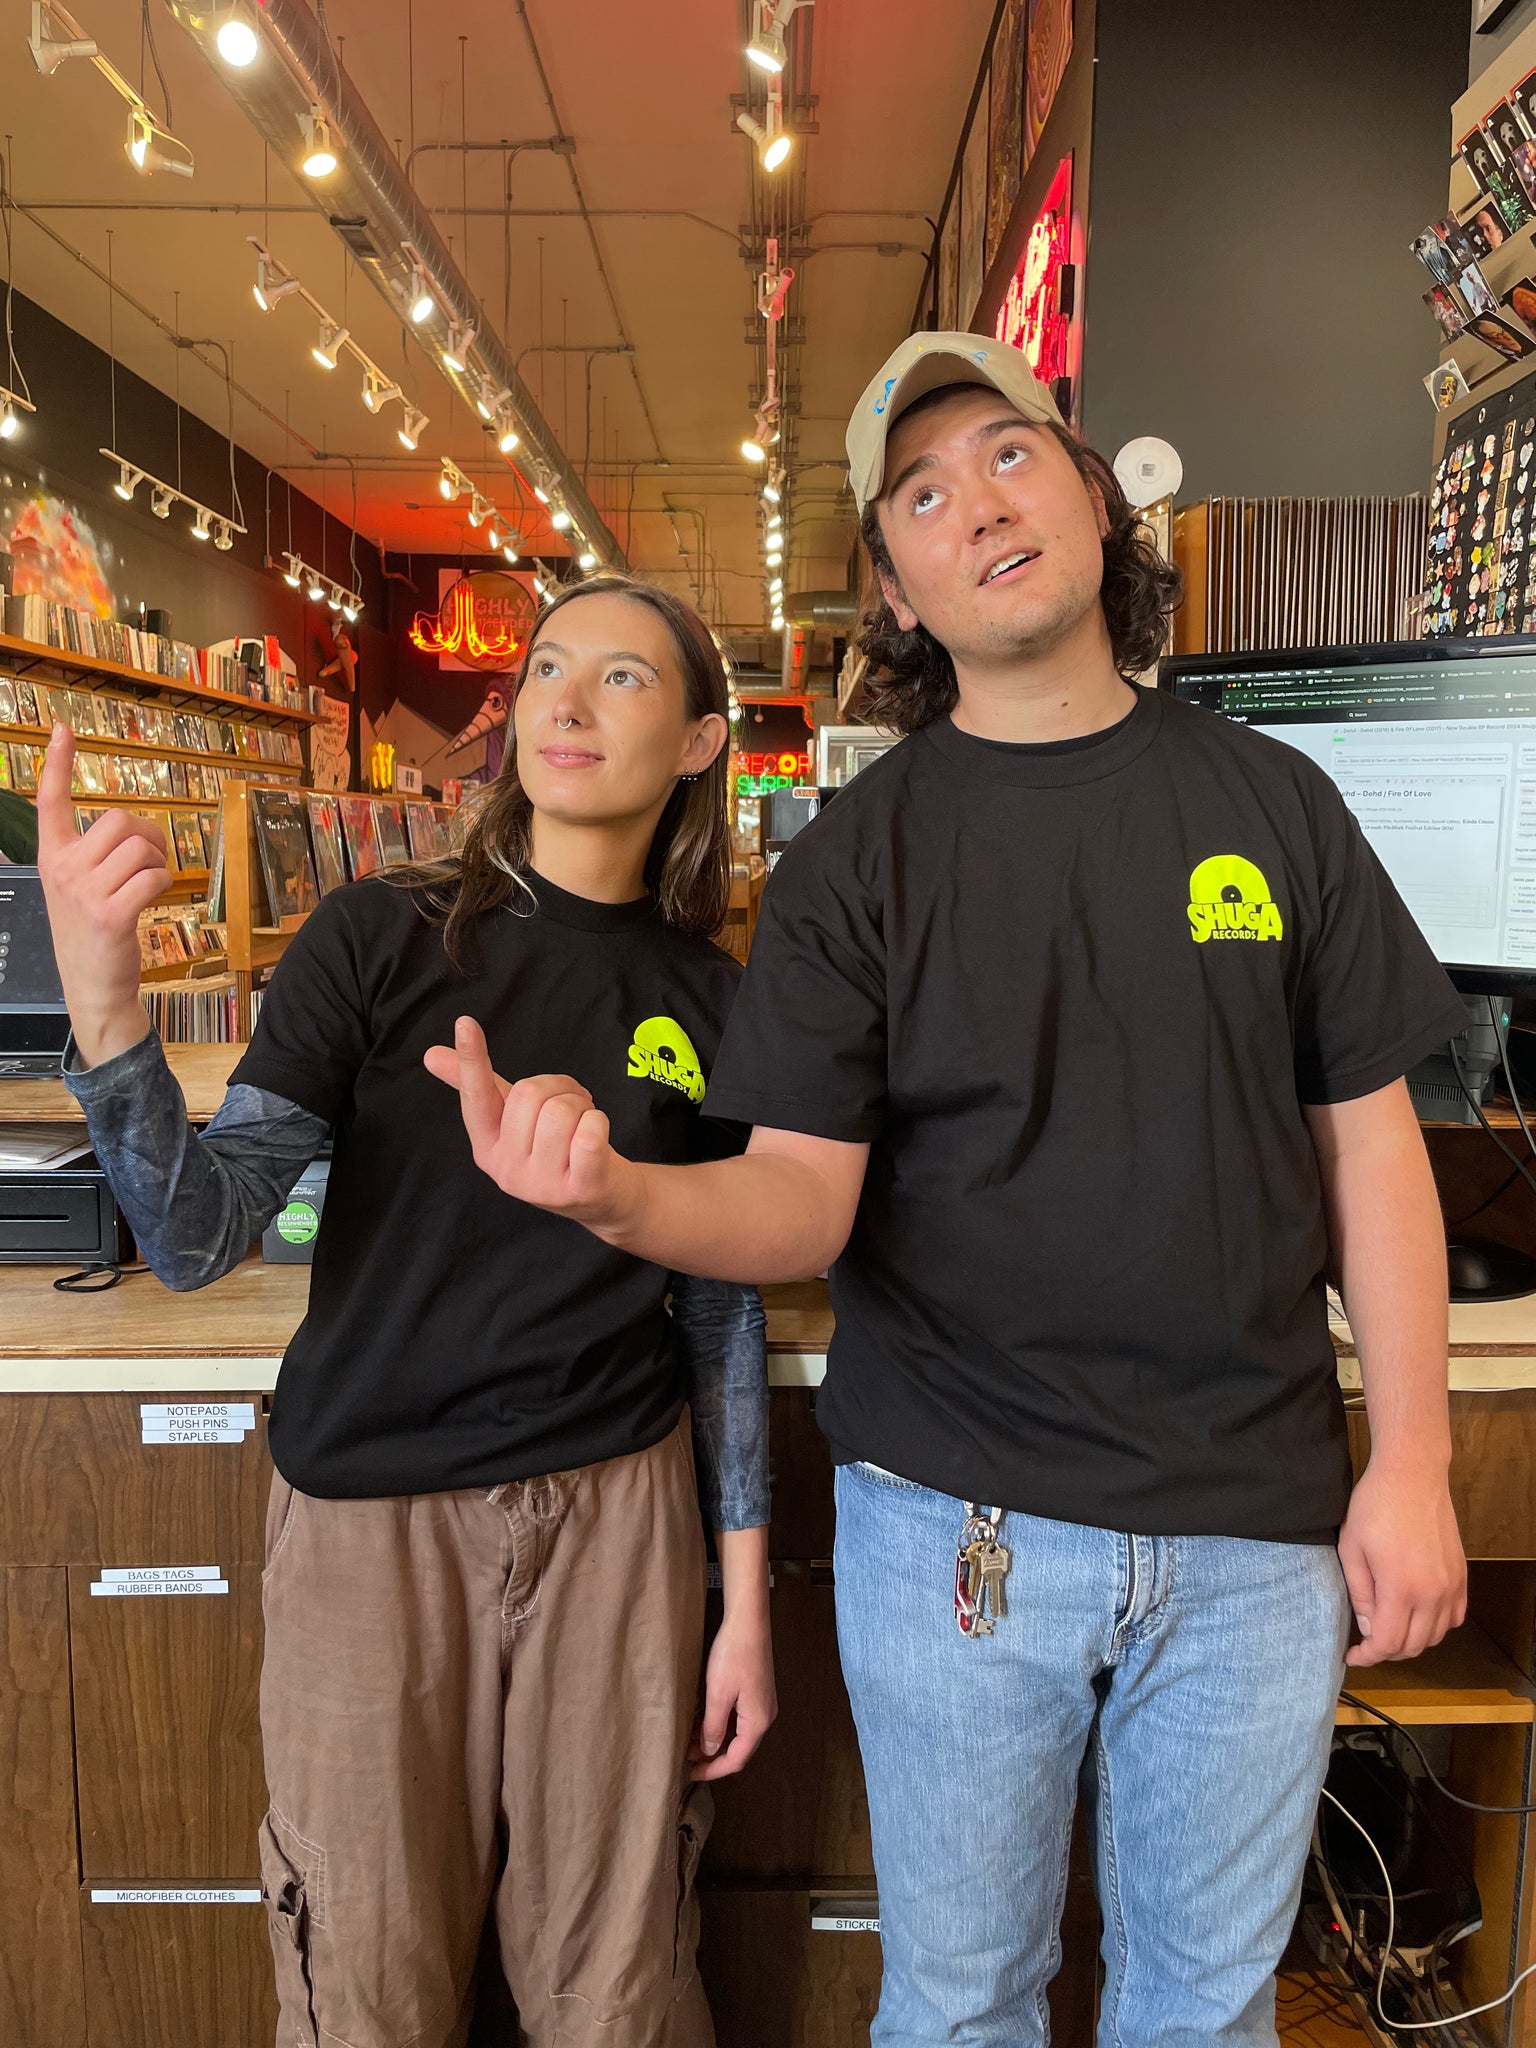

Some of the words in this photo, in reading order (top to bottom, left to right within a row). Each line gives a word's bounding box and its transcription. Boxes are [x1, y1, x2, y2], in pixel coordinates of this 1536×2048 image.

[447, 598, 531, 616] GHLY
[1187, 902, 1283, 943] SHUGA
[1212, 930, 1257, 940] RECORDS
[627, 1044, 706, 1104] SHUGA
[649, 1072, 688, 1094] RECORDS
[279, 1212, 316, 1221] HIGHLY
[167, 1406, 228, 1416] NOTEPADS
[169, 1419, 200, 1429] PUSH
[203, 1419, 229, 1428] PINS
[168, 1432, 219, 1441] STAPLES
[128, 1571, 160, 1580] BAGS
[163, 1570, 194, 1579] TAGS
[117, 1584, 163, 1593] RUBBER
[165, 1583, 203, 1593] BANDS
[116, 1892, 183, 1901] MICROFIBER
[185, 1892, 236, 1901] CLOTHES
[836, 1920, 880, 1929] STICKER
